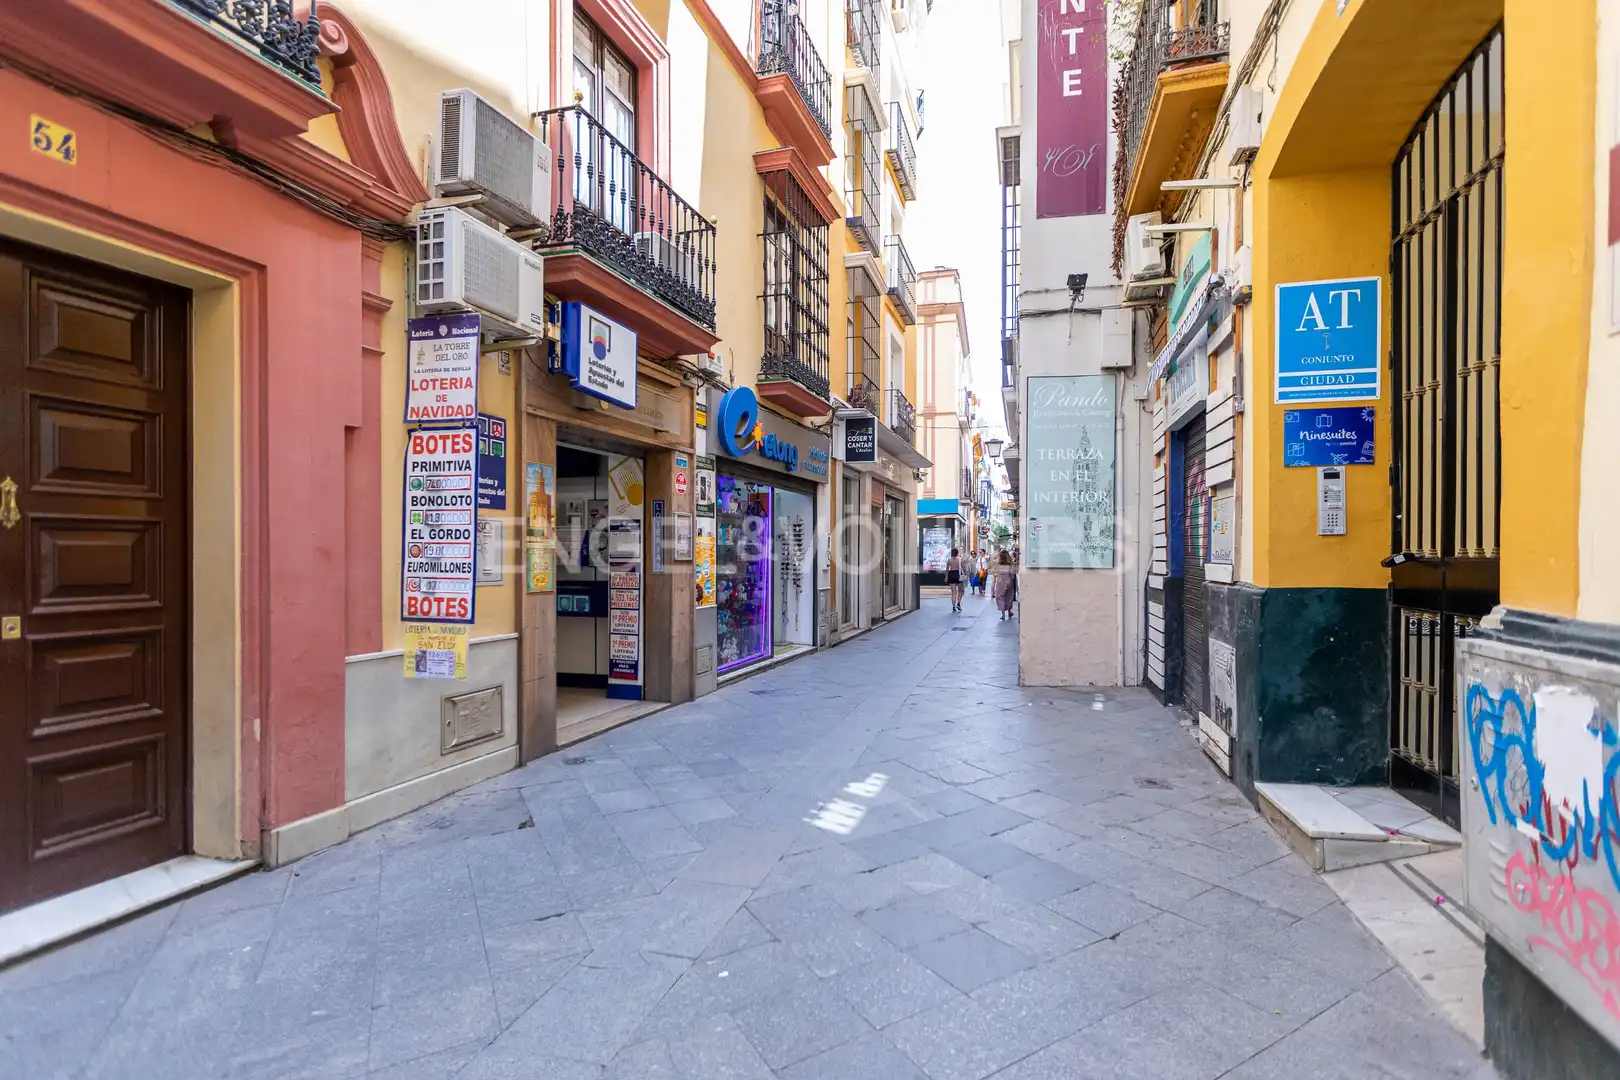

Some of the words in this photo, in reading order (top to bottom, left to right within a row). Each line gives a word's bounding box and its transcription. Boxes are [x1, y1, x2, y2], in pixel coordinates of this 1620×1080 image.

[34, 120, 75, 162] 54
[1295, 289, 1361, 332] AT
[452, 326, 478, 335] Nacional
[433, 344, 443, 352] LA
[445, 342, 470, 351] TORRE
[435, 353, 451, 362] DEL
[452, 352, 468, 361] ORO
[1301, 354, 1354, 365] CONJUNTO
[411, 377, 473, 391] LOTERIA
[588, 377, 608, 390] Estado
[1300, 374, 1355, 386] CIUDAD
[435, 394, 448, 403] DE
[1033, 382, 1108, 408] Pando
[409, 404, 474, 419] NAVIDAD
[1299, 428, 1357, 441] Ninesuites
[412, 433, 473, 454] BOTES
[1037, 448, 1104, 460] TERRAZA
[411, 460, 472, 473] PRIMITIVA
[1050, 470, 1069, 482] EN
[1076, 470, 1092, 482] EL
[411, 495, 473, 507] BONOLOTO
[1034, 491, 1109, 503] INTERIOR
[411, 528, 424, 540] EL
[429, 528, 471, 540] GORDO
[407, 562, 472, 574] EUROMILLONES
[407, 596, 469, 618] BOTES
